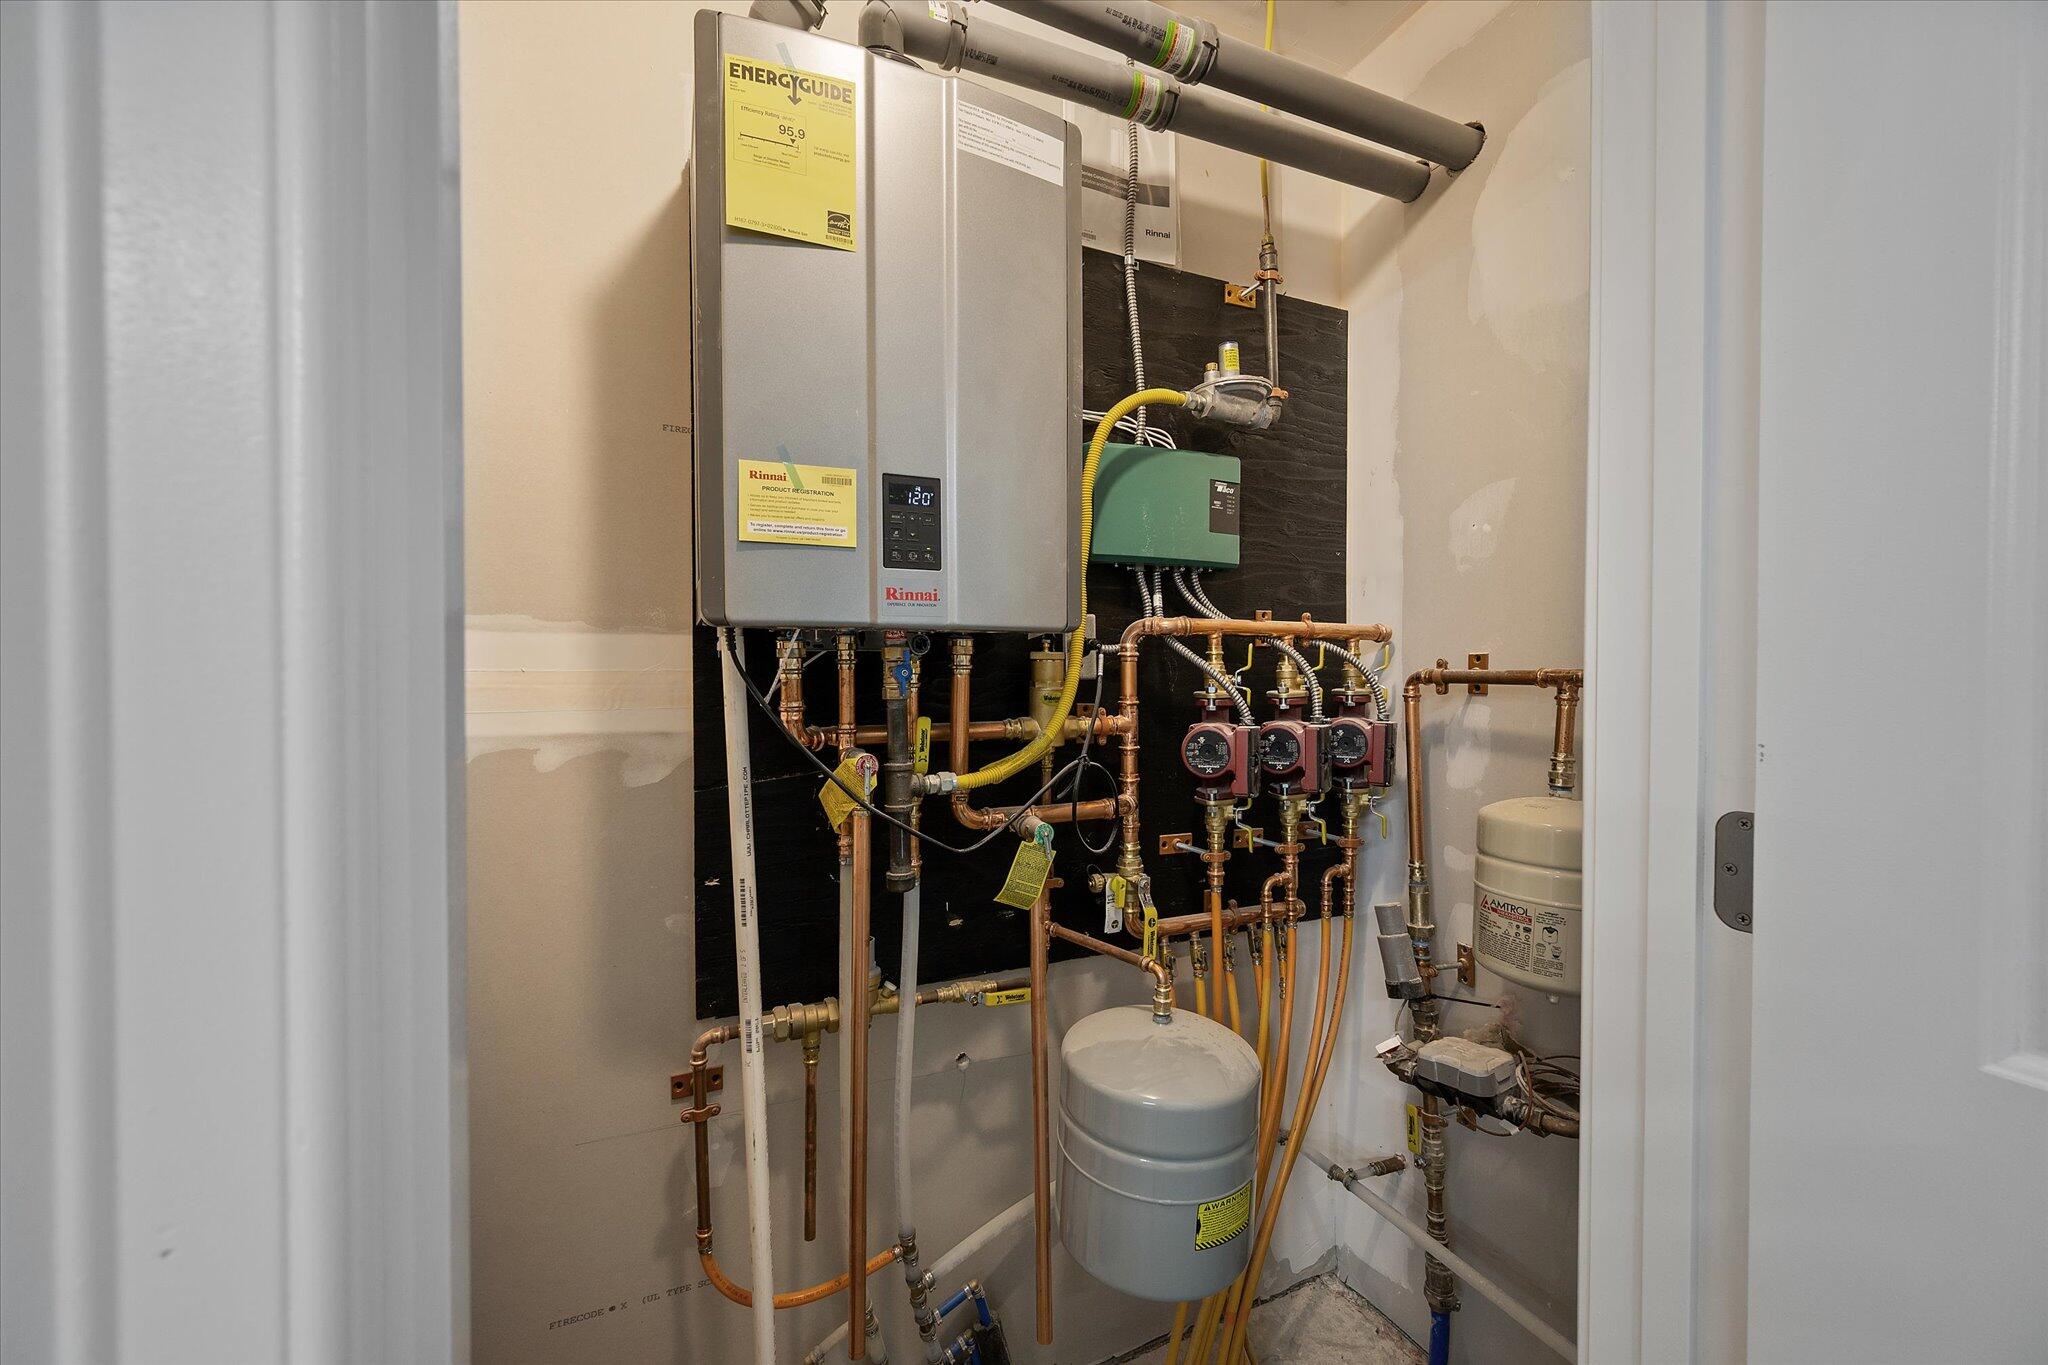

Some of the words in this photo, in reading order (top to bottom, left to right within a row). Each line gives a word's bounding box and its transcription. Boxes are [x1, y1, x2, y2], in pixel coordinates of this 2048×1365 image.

[779, 124, 805, 140] 95.9
[1145, 229, 1171, 239] Rinnai
[749, 470, 787, 481] Rinnai
[762, 485, 791, 494] PRODUCT
[792, 488, 835, 497] REGISTRATION
[885, 587, 938, 601] Rinnai
[1490, 899, 1528, 916] AMTROL
[549, 1308, 605, 1331] FIRECODE
[641, 1293, 661, 1305] (UL
[666, 1283, 692, 1298] TYPE
